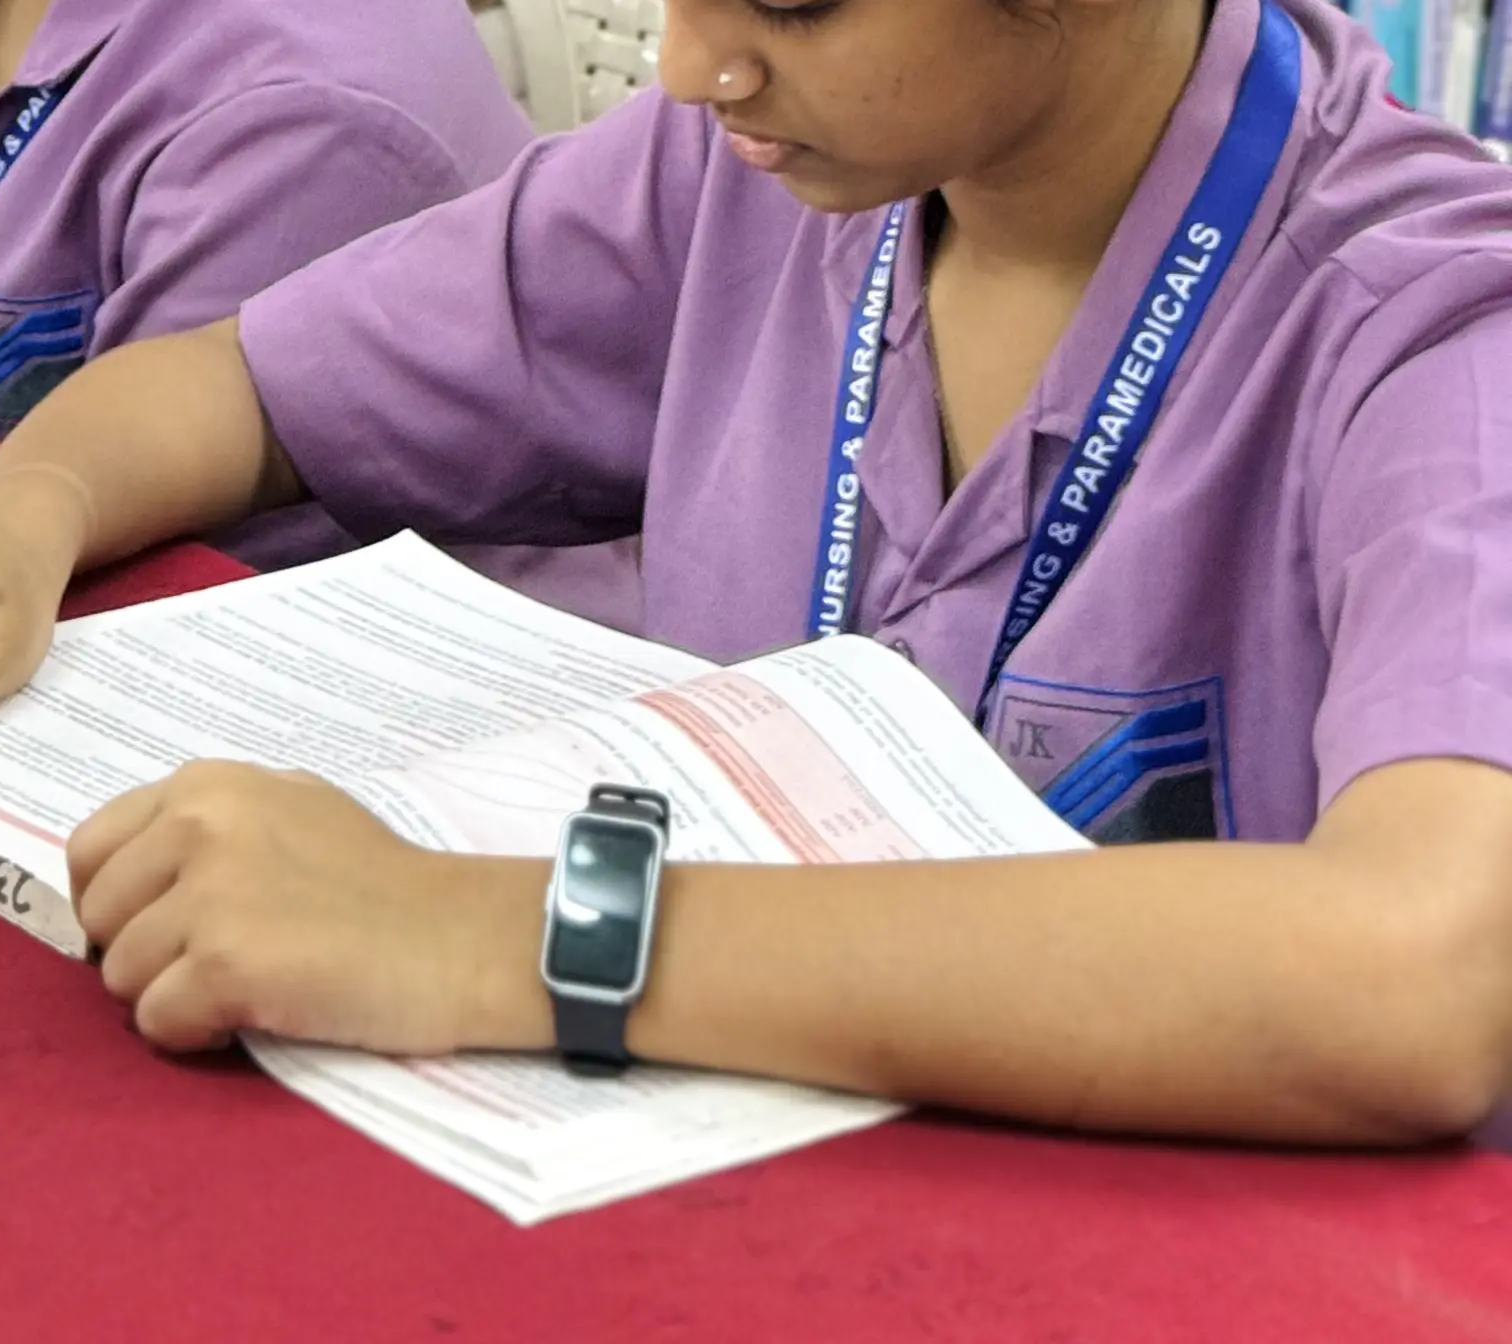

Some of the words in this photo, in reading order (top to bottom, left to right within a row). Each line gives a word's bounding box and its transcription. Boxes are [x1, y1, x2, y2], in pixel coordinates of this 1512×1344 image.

[3, 134, 23, 156] &
[1061, 220, 1223, 512] PARAMEDICALS
[841, 436, 865, 462] &
[1048, 520, 1080, 546] &
[1009, 717, 1056, 760] JK
